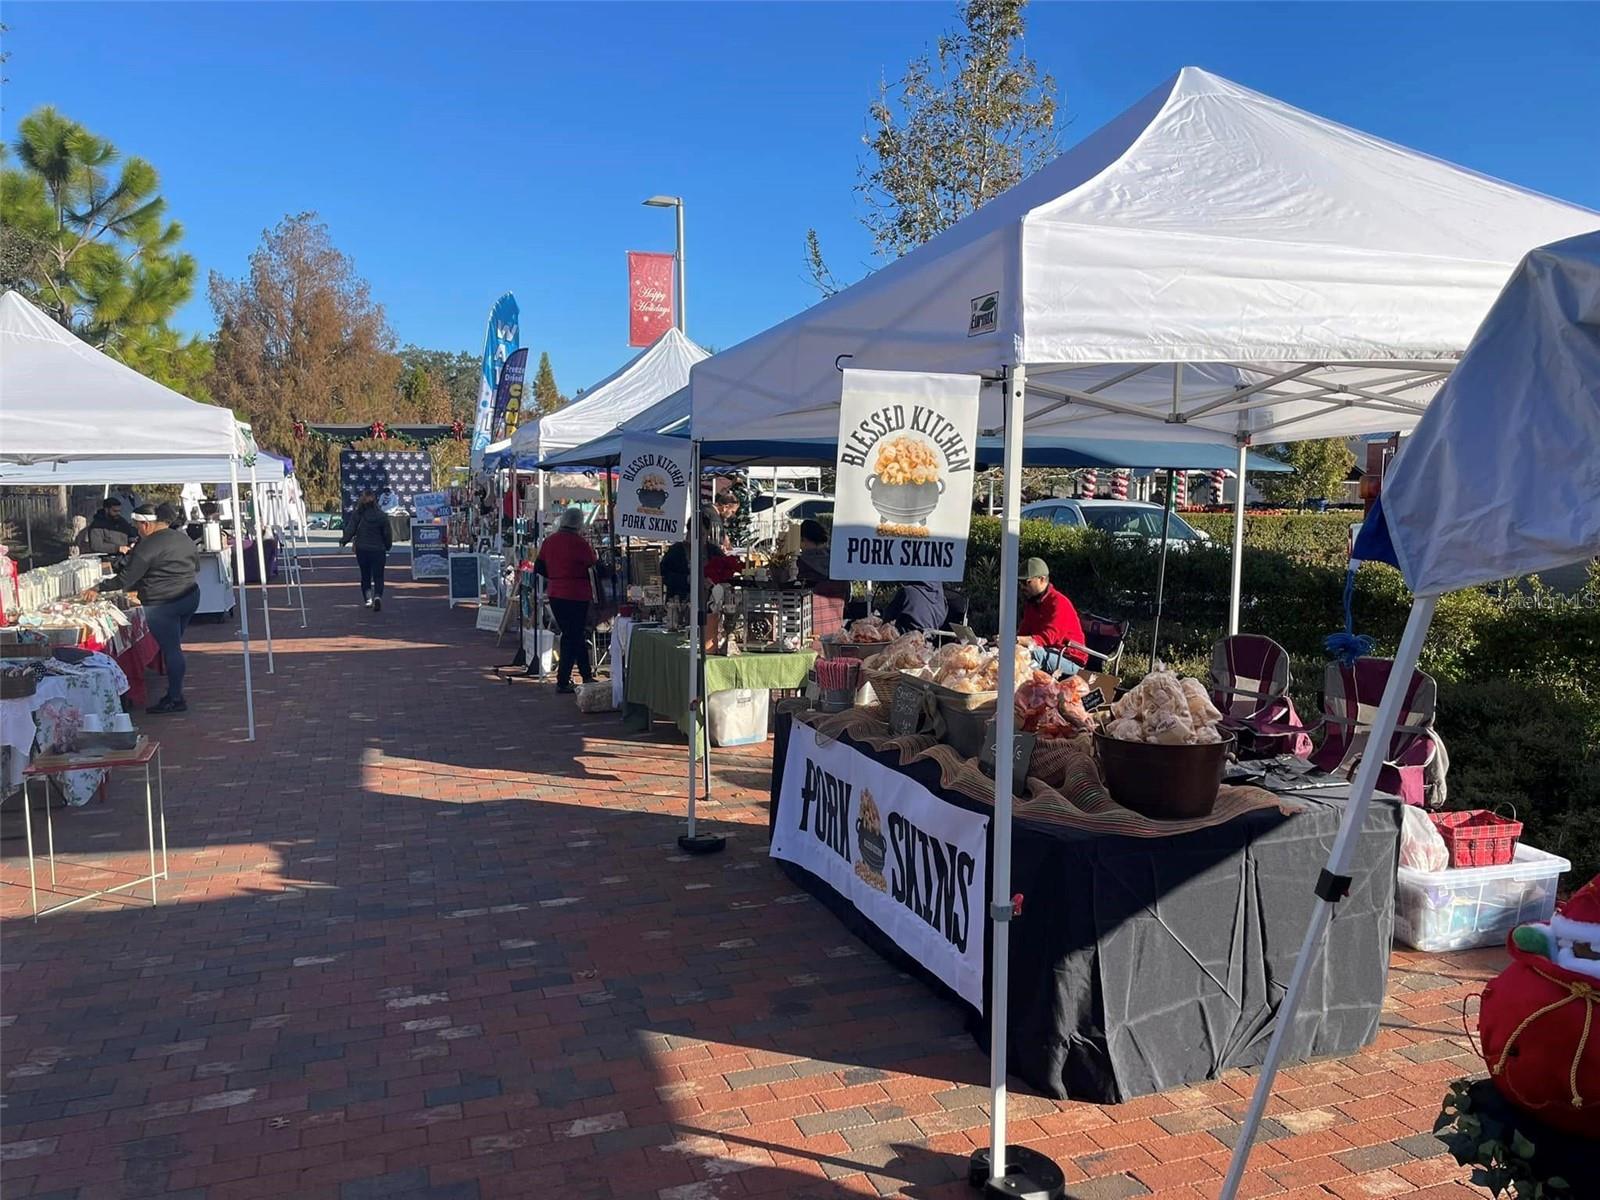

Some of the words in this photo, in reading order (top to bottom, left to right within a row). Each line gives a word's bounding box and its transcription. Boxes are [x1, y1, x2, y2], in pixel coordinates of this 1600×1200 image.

[633, 299, 671, 316] Holidays
[638, 286, 666, 302] Happy
[840, 404, 906, 468] BLESSED
[910, 405, 971, 473] KITCHEN
[622, 454, 655, 482] BLESSED
[656, 454, 685, 488] KITCHEN
[622, 514, 646, 530] PORK
[648, 517, 677, 533] SKINS
[847, 537, 895, 566] PORK
[899, 539, 954, 568] SKINS
[799, 757, 852, 864] PORK
[887, 811, 975, 954] SKINS
